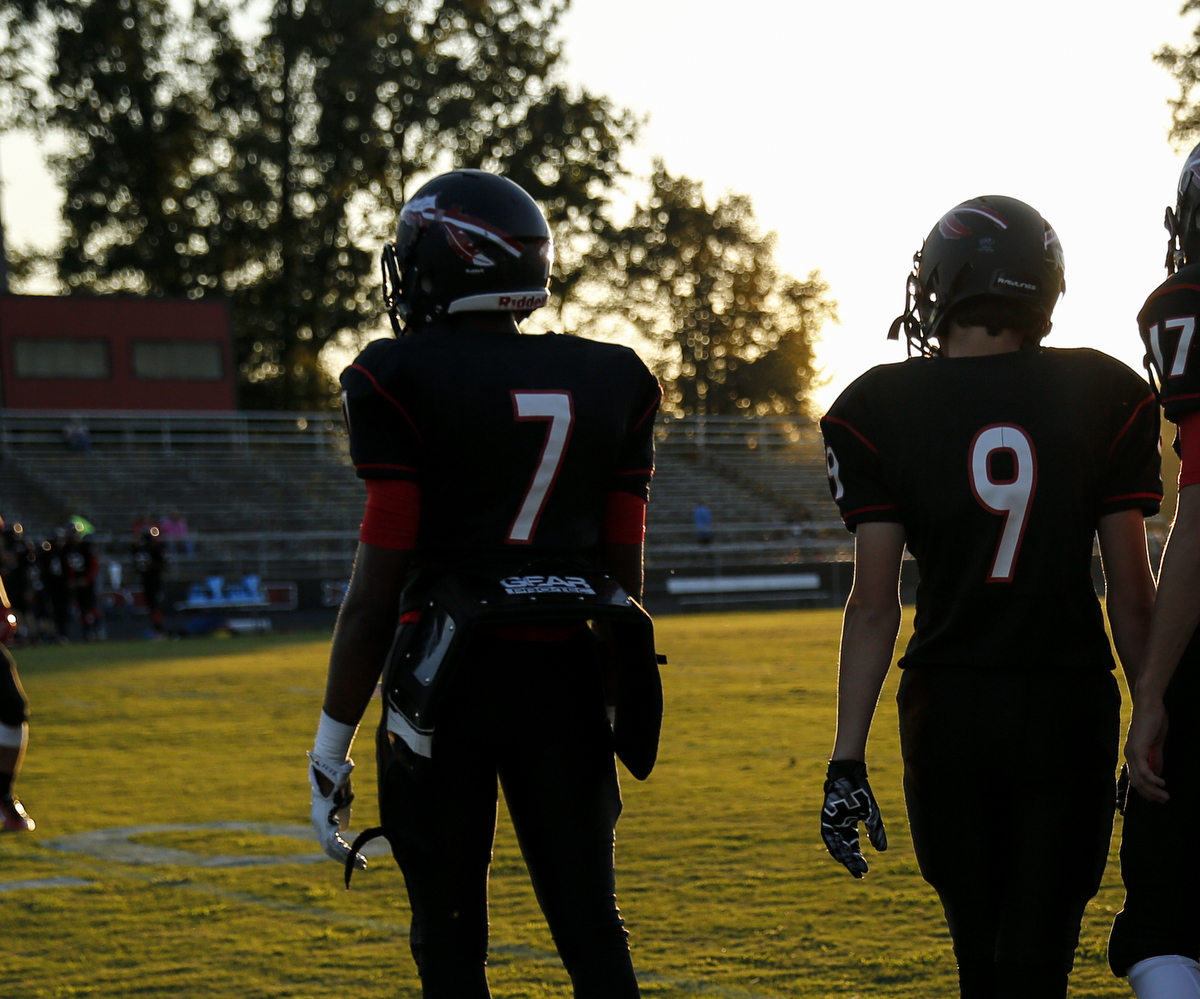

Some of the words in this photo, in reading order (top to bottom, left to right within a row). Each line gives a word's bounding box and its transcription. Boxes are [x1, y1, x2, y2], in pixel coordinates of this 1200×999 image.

[1148, 314, 1197, 380] 17
[504, 388, 576, 545] 7
[826, 444, 845, 501] 9
[967, 422, 1039, 583] 9
[500, 575, 592, 589] GEAR
